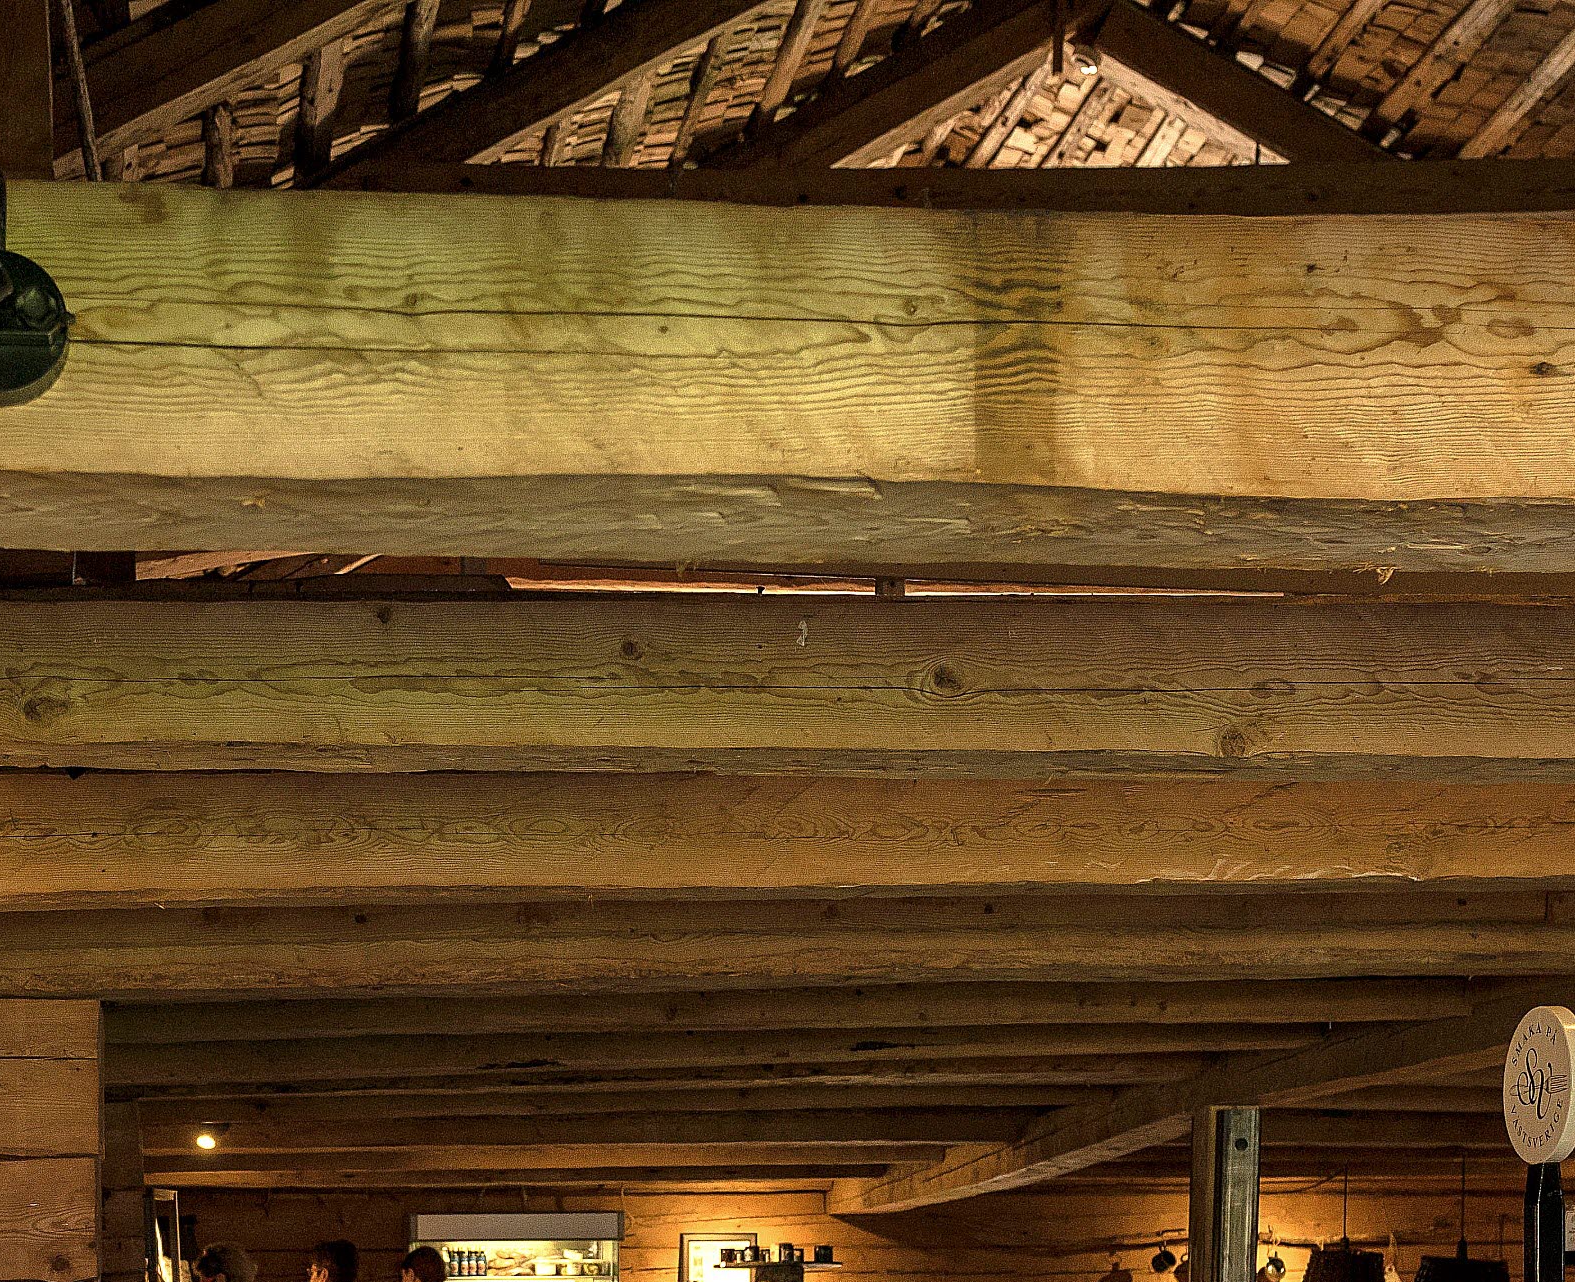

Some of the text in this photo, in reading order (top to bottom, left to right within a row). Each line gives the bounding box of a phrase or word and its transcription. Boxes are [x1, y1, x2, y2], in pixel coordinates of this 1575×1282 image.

[1512, 1022, 1557, 1067] SMAKA PÅ
[1510, 1098, 1563, 1149] VÄSTSVERIGE
